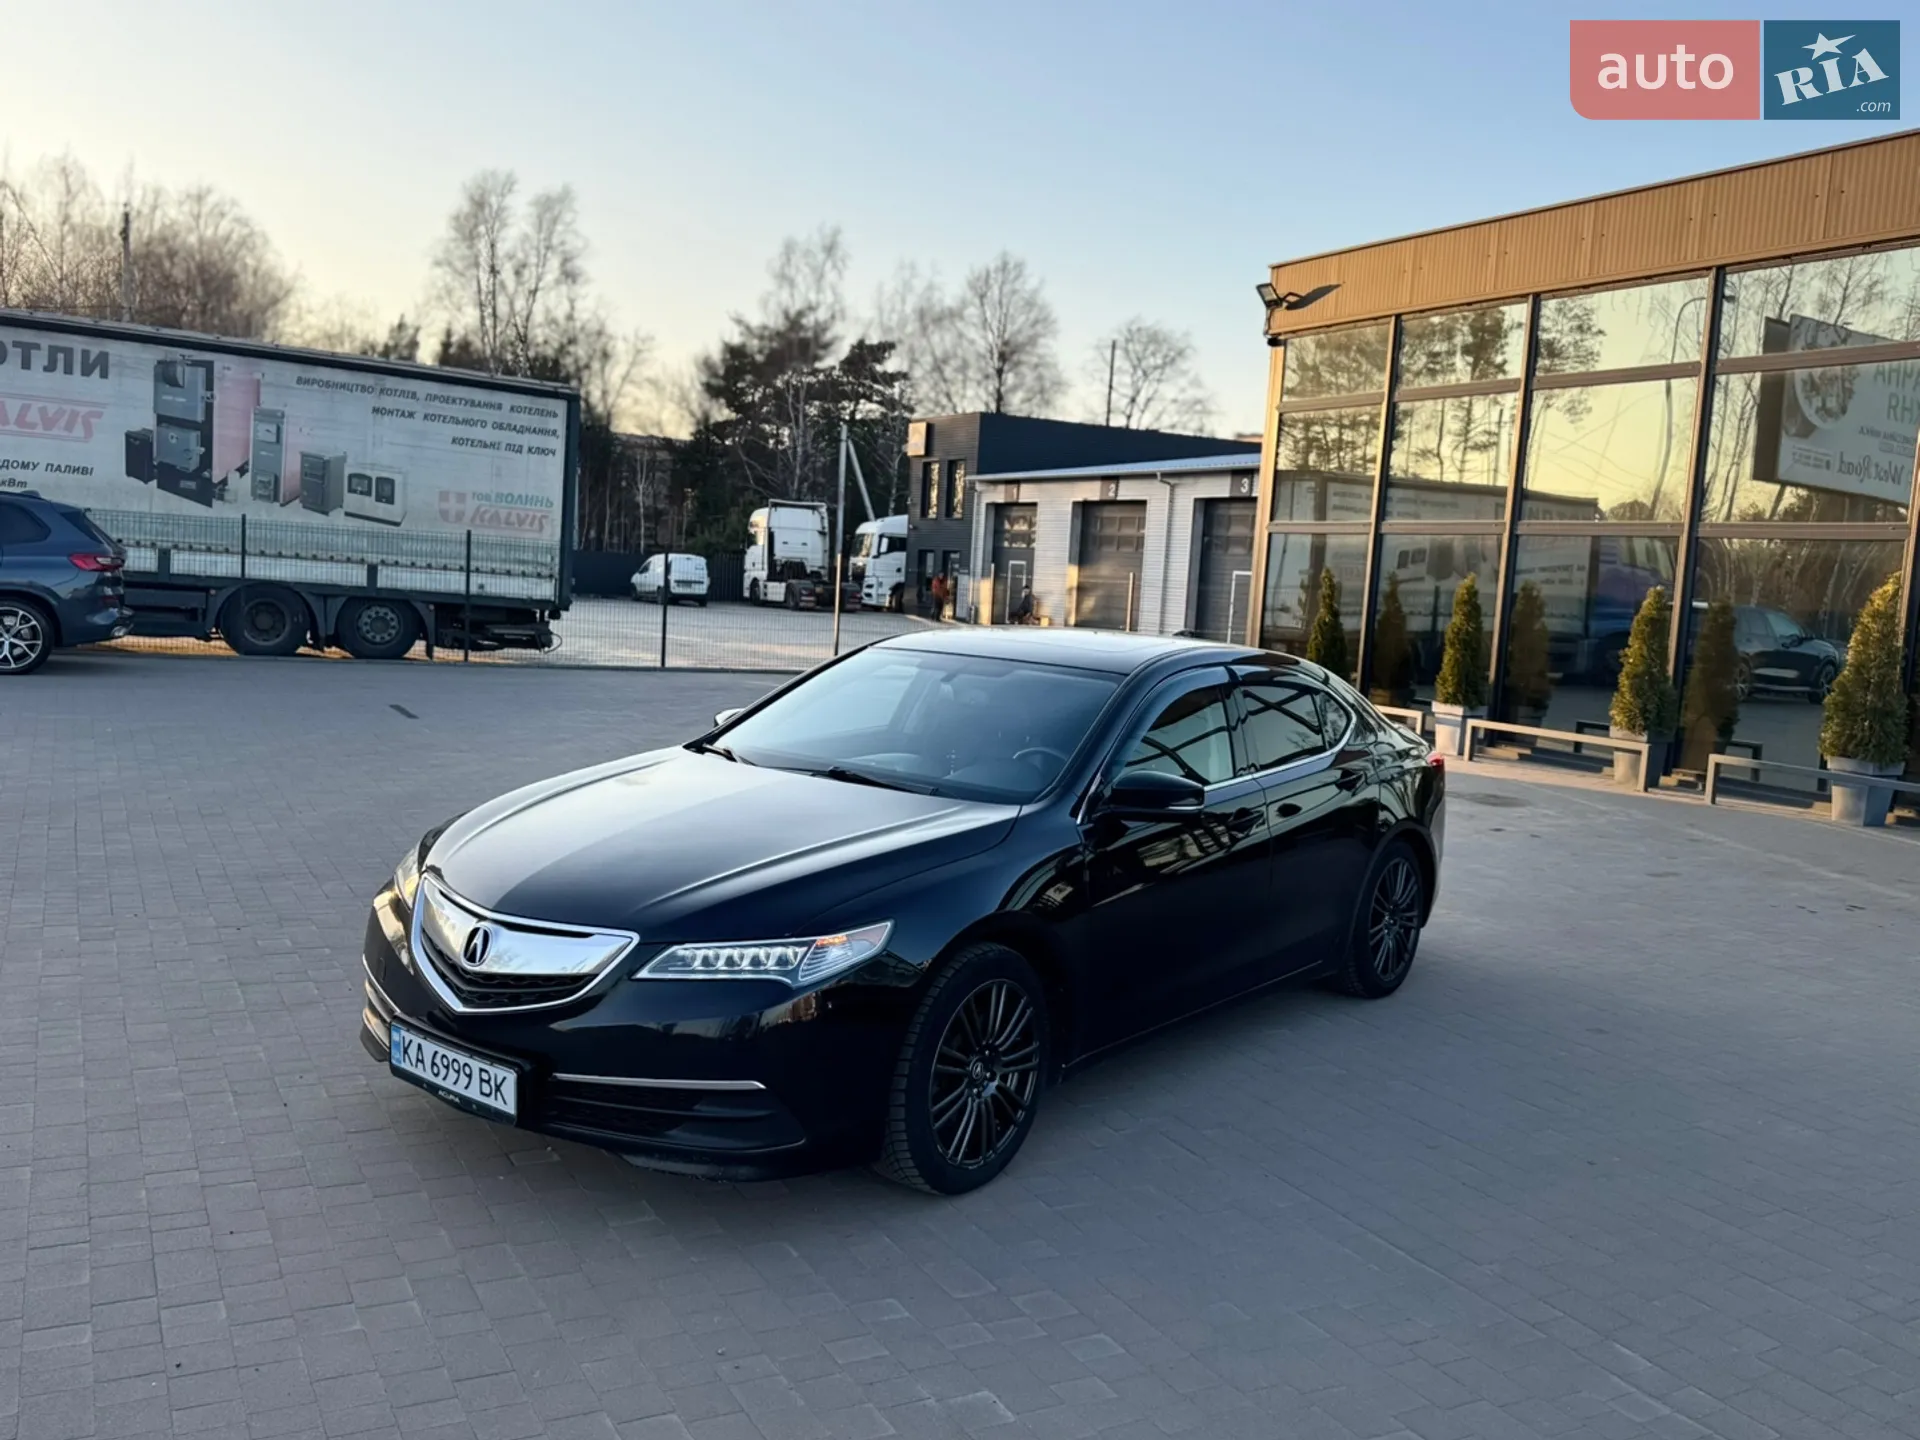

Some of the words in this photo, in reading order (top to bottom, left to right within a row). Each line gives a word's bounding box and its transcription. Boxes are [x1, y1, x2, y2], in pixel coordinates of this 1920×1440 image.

[296, 376, 375, 394] ВИРОБНИЦТВО
[379, 386, 420, 401] КОТЛІВ,
[425, 393, 503, 411] ПРОЕКТУВАННЯ
[509, 404, 559, 419] КОТЕЛЕНЬ
[371, 406, 417, 420] МОНТАЖ
[423, 412, 488, 429] КОТЕЛЬНОГО
[491, 421, 560, 439] ОБЛАДНАННЯ,
[451, 436, 501, 451] КОТЕЛЬНІ
[504, 442, 524, 455] ПІД
[527, 445, 557, 458] КЛЮЧ
[45, 463, 94, 476] ПАЛИВІ
[1108, 484, 1116, 497] 2
[1240, 478, 1249, 493] 3
[494, 492, 554, 508] ВОЛИНЬ
[402, 1035, 426, 1072] KA
[430, 1050, 473, 1090] 6999
[479, 1067, 507, 1105] BK
